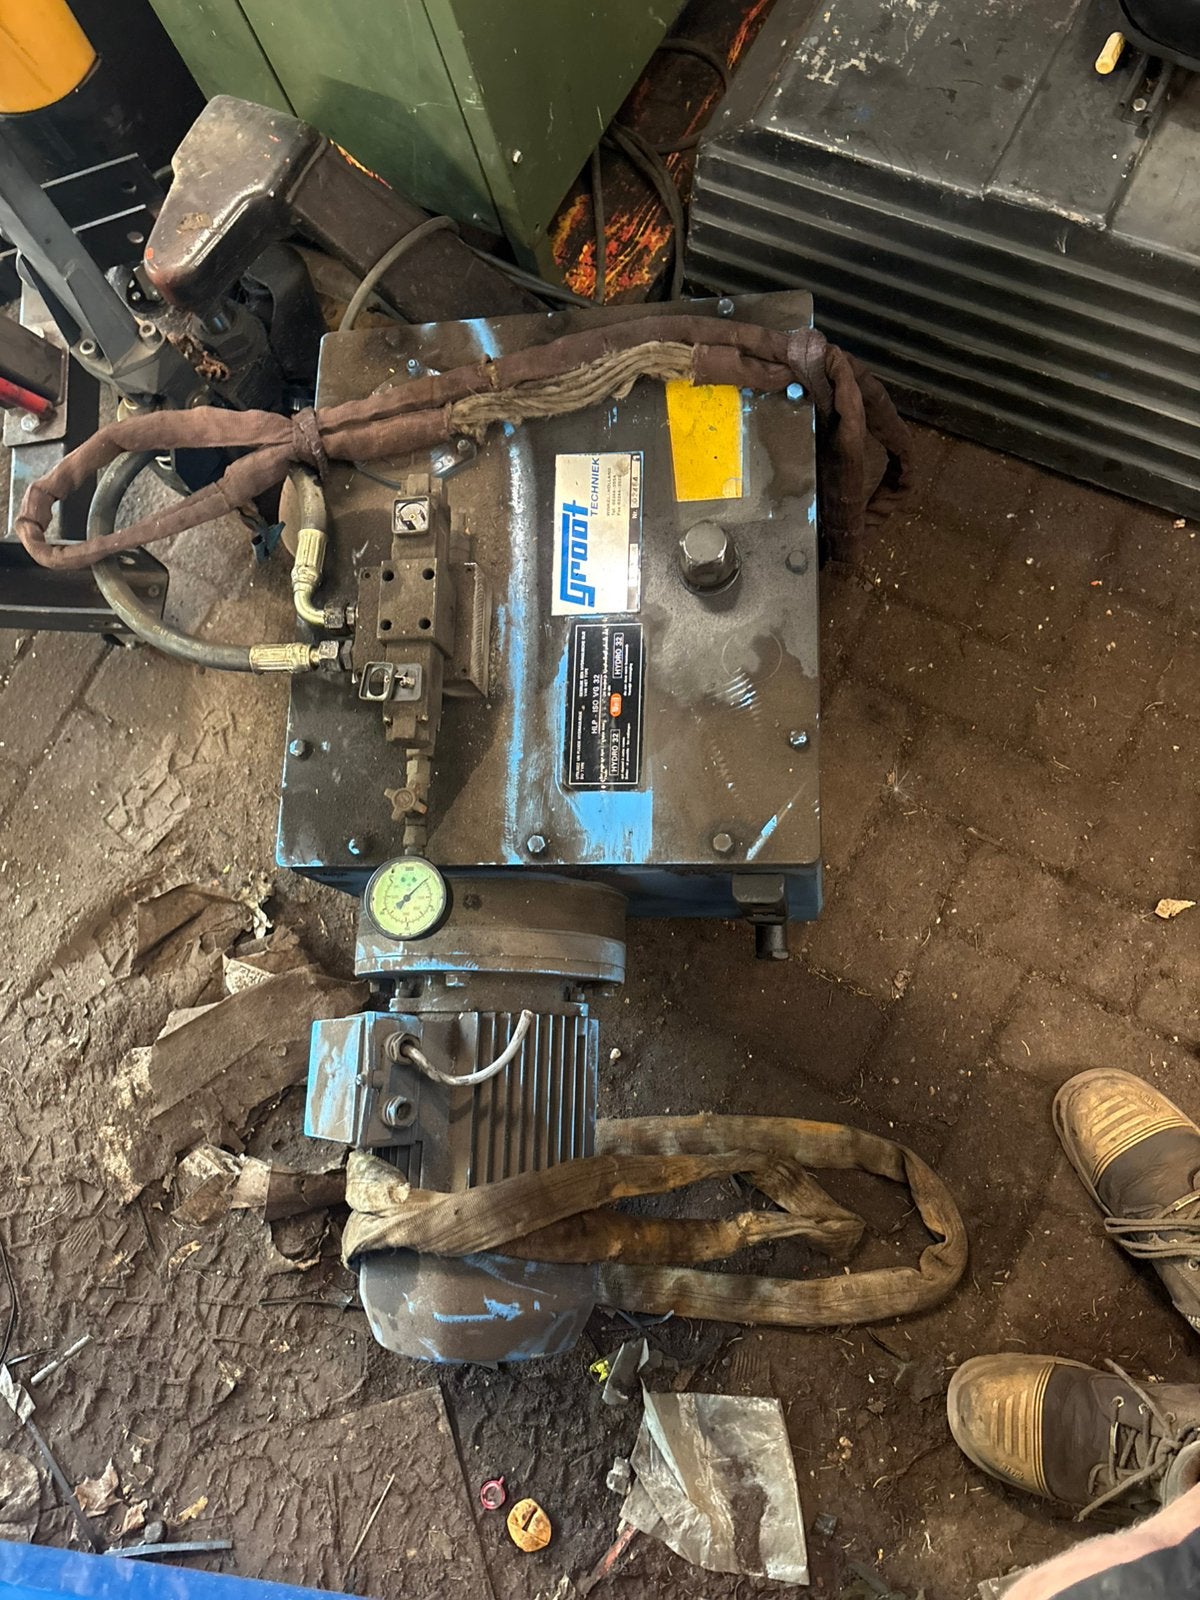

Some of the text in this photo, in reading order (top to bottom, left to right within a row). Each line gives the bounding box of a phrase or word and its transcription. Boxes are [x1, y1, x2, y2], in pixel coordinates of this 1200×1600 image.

[590, 458, 600, 516] TECHNIEK
[560, 500, 595, 608] groot
[616, 636, 622, 646] 32
[594, 674, 600, 684] 32
[592, 686, 599, 698] VG
[612, 734, 619, 742] 32
